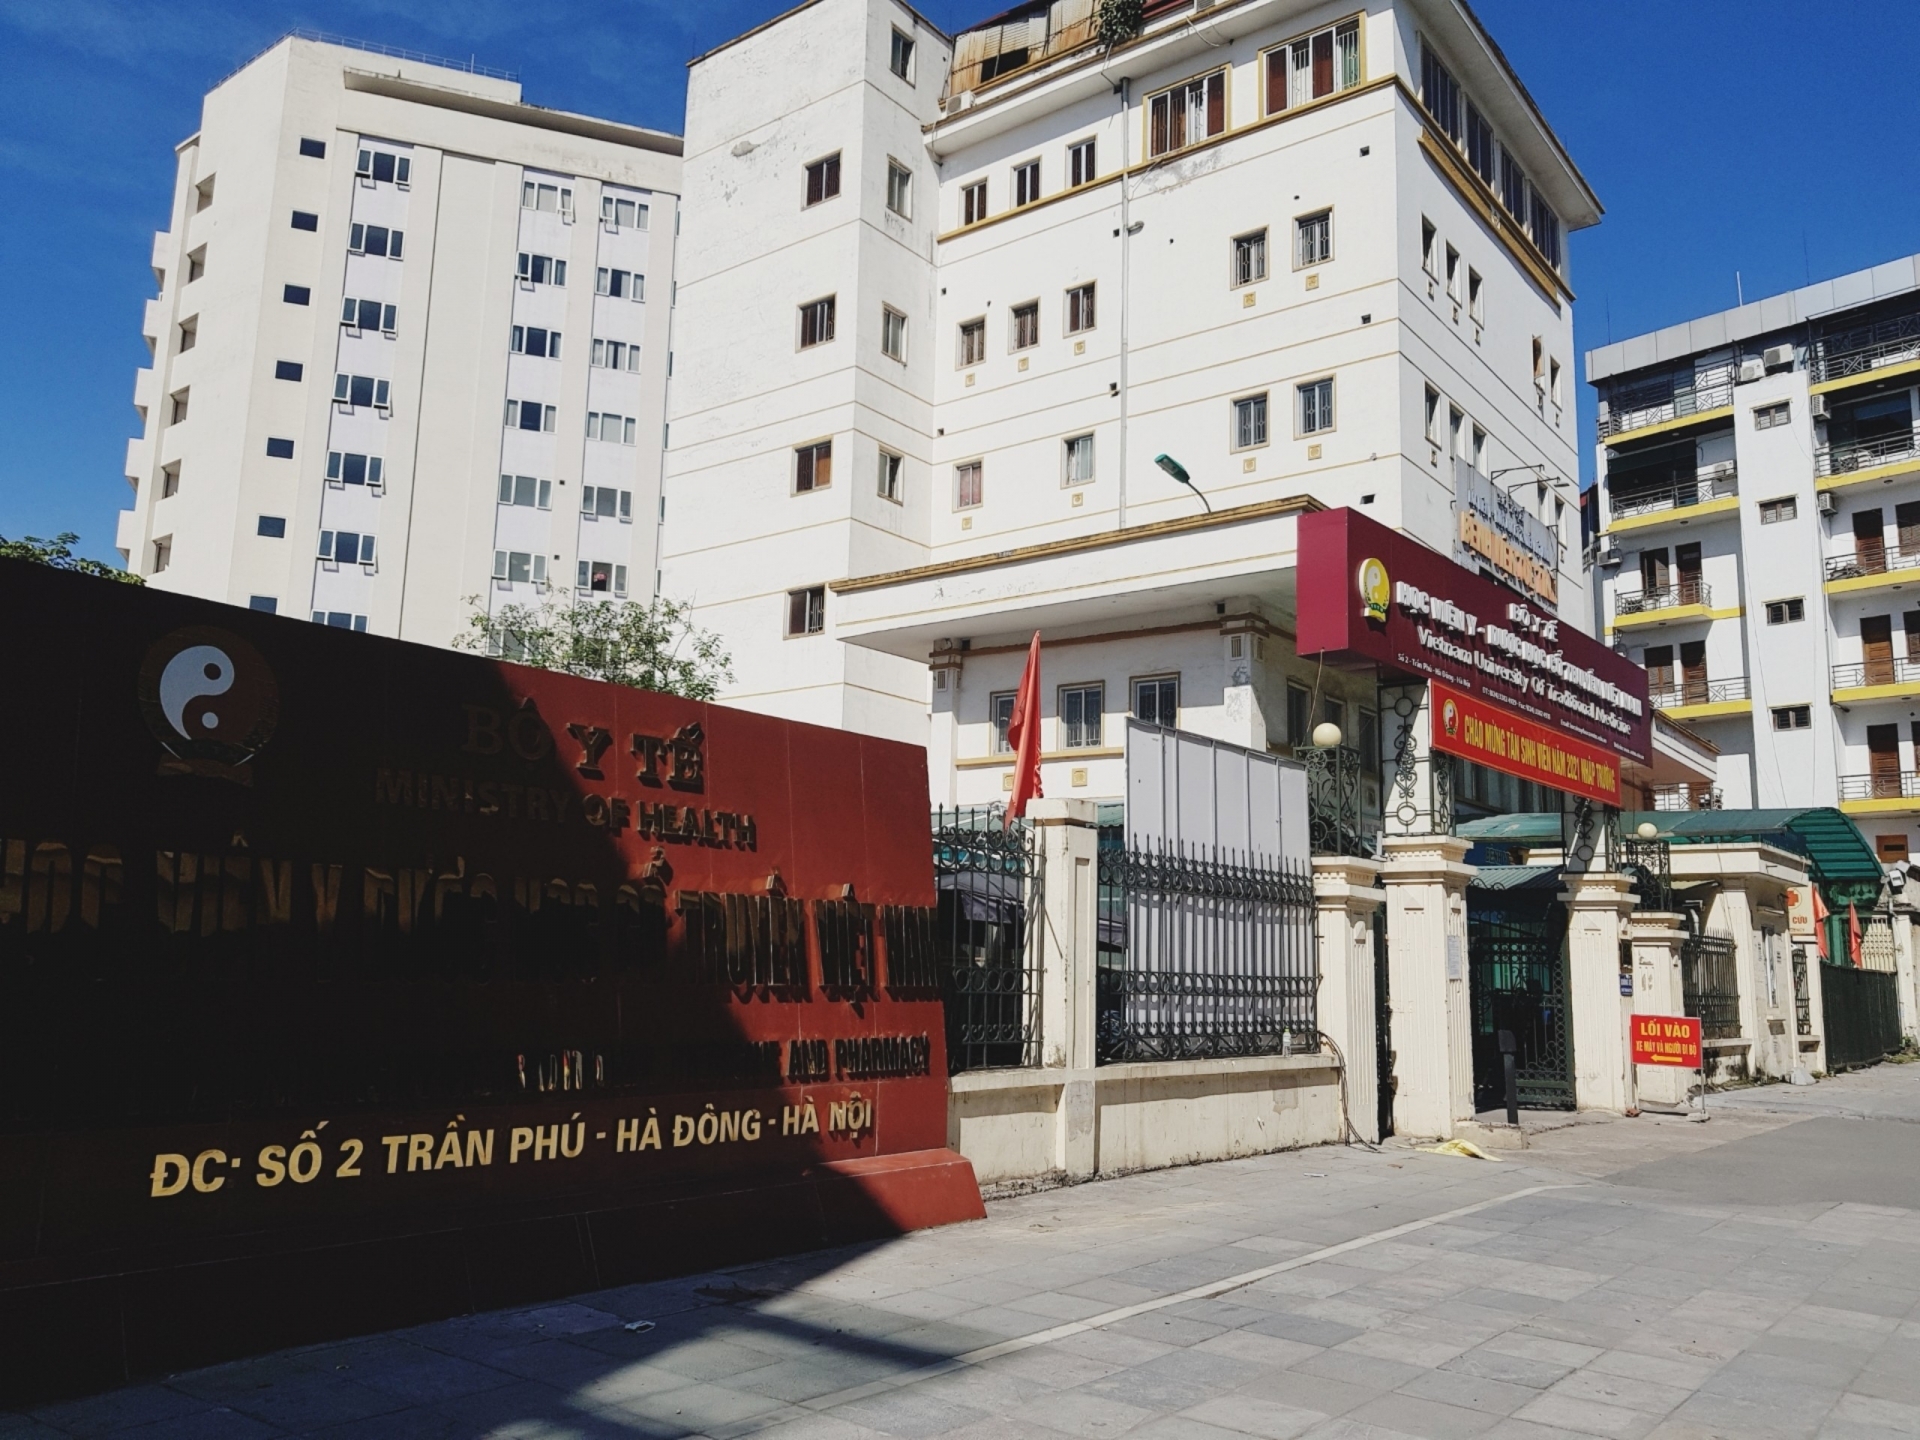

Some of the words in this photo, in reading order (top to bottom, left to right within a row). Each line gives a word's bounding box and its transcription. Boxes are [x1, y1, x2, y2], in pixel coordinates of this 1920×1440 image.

[1395, 581, 1429, 614] HỌC
[1430, 597, 1466, 632] VIỆN
[1466, 613, 1478, 636] Y
[1485, 624, 1522, 658] DƯỢC
[1521, 641, 1547, 669] HỌC
[1546, 650, 1564, 676] CỔ
[1563, 661, 1601, 698] TRUYỀN
[1600, 681, 1621, 707] VIỆT
[1619, 690, 1643, 716] NAM
[1507, 603, 1531, 632] BỘ
[1530, 613, 1541, 632] Y
[1541, 619, 1559, 643] TẾ
[1418, 625, 1473, 665] Vietnam
[1474, 650, 1529, 694] University
[1531, 676, 1546, 696] Of
[1548, 683, 1596, 718] Traditional
[1595, 703, 1632, 735] Medicine
[567, 722, 612, 776] Y
[630, 721, 705, 791] TẾ
[1464, 712, 1484, 749] CHÀO
[1484, 720, 1506, 757] MỪNG
[1506, 727, 1520, 762] TÂN
[1520, 736, 1537, 768] SINH
[1537, 739, 1552, 772] VIÊN
[1552, 744, 1567, 778] NĂM
[1566, 753, 1580, 781] 2021
[1580, 755, 1595, 791] NHẬP
[1595, 761, 1616, 793] TRƯỜNG
[375, 766, 575, 824] MINISTRY
[583, 792, 630, 830] OF
[637, 800, 756, 848] HEALTH
[880, 903, 940, 990] NAM
[787, 1039, 829, 1078] AND
[833, 1034, 931, 1077] PHARMACY
[1635, 1040, 1643, 1052] XE
[1643, 1038, 1656, 1053] MÁY
[1656, 1039, 1664, 1053] VÀ
[1664, 1040, 1682, 1055] NGƯỜI
[1681, 1043, 1689, 1055] ĐI
[1688, 1041, 1697, 1058] BỘ
[1640, 1018, 1661, 1037] LỐI
[1663, 1021, 1690, 1039] VÀO
[255, 1119, 330, 1188] SỐ
[335, 1138, 364, 1178] 2
[381, 1113, 495, 1174] TRẦN
[508, 1111, 586, 1165] PHÚ
[615, 1106, 663, 1153] HÀ
[672, 1102, 762, 1148] ĐÔNG
[782, 1095, 821, 1137] HÀ
[828, 1090, 873, 1139] NỘI
